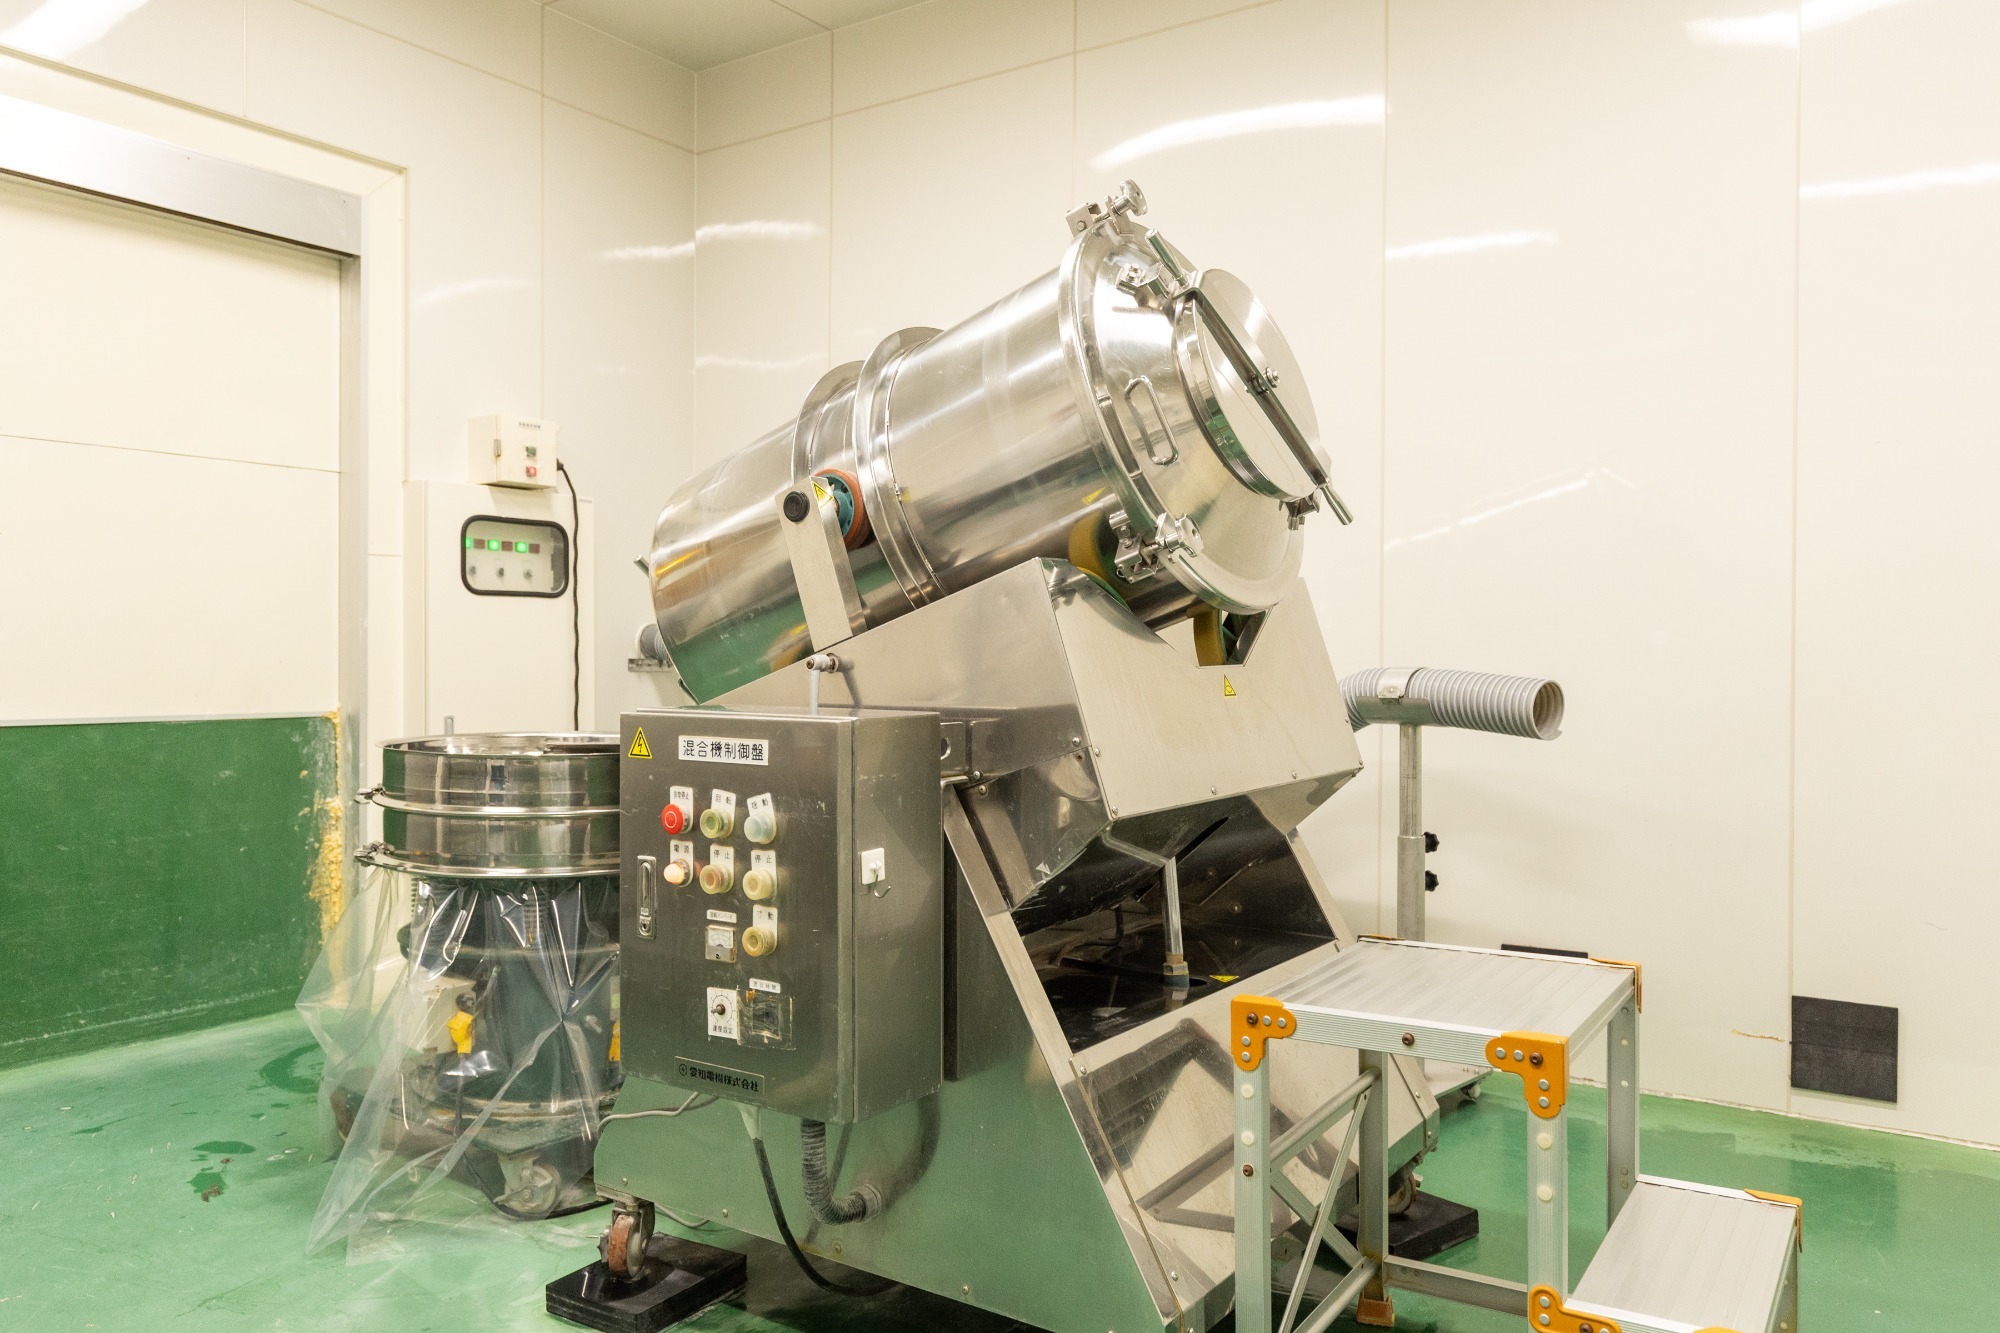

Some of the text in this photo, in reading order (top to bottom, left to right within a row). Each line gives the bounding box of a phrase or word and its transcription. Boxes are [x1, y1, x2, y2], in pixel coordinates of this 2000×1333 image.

[683, 740, 764, 761] 混合機制御盤
[715, 793, 732, 805] 回転
[713, 849, 731, 860] 停止
[754, 854, 772, 864] 停止
[689, 1066, 759, 1092] 愛知電機株式会社
